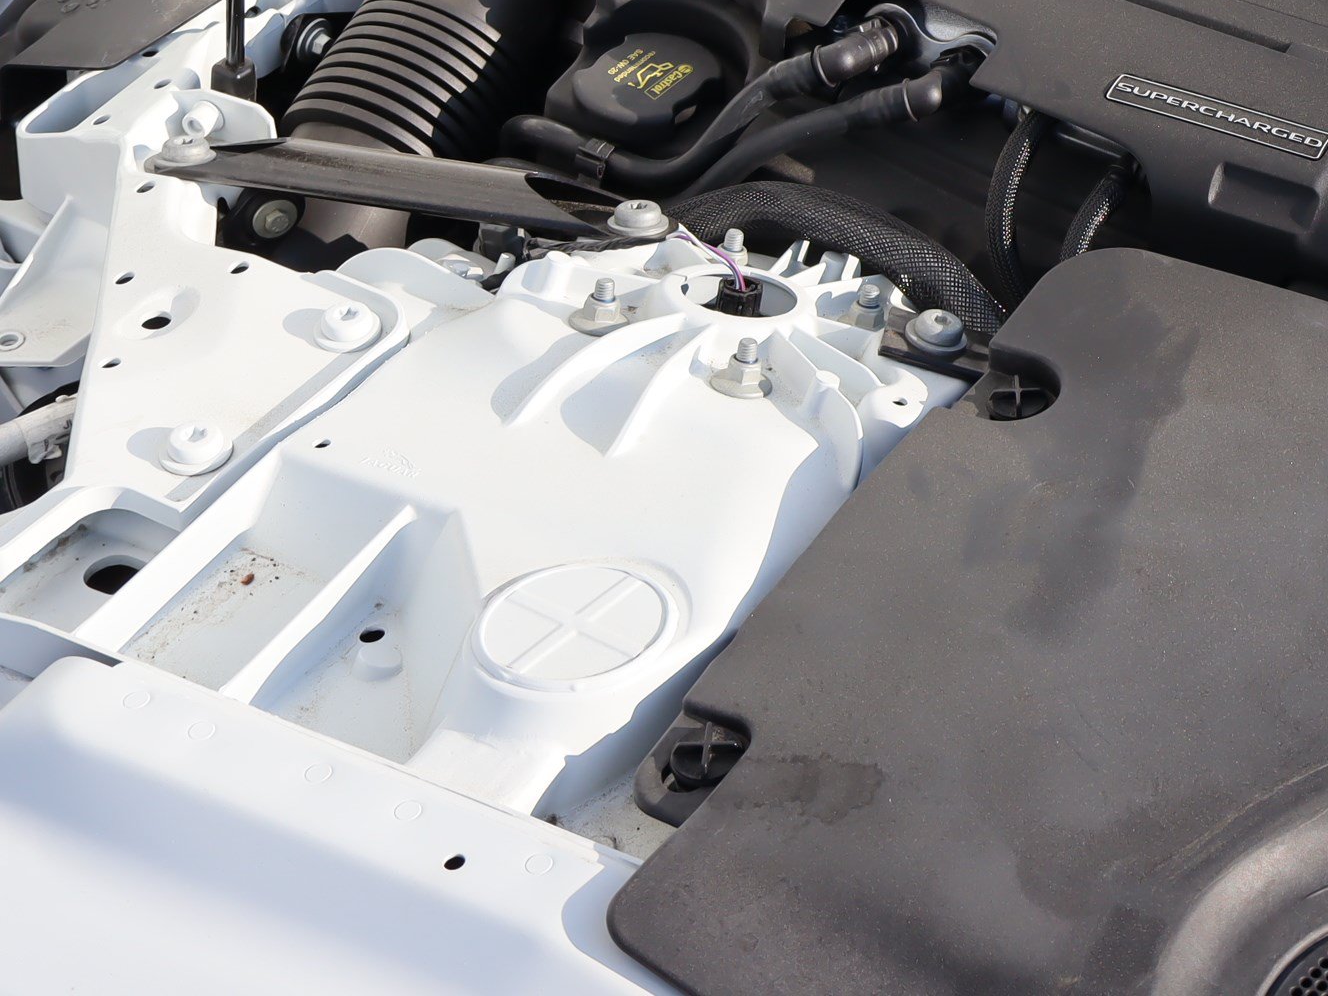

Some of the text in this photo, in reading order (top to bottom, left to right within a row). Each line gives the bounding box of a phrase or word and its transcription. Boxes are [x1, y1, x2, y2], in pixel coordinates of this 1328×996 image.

[627, 49, 644, 61] SAE
[651, 70, 683, 95] Castrol
[1116, 82, 1323, 147] SUPERCHARGED
